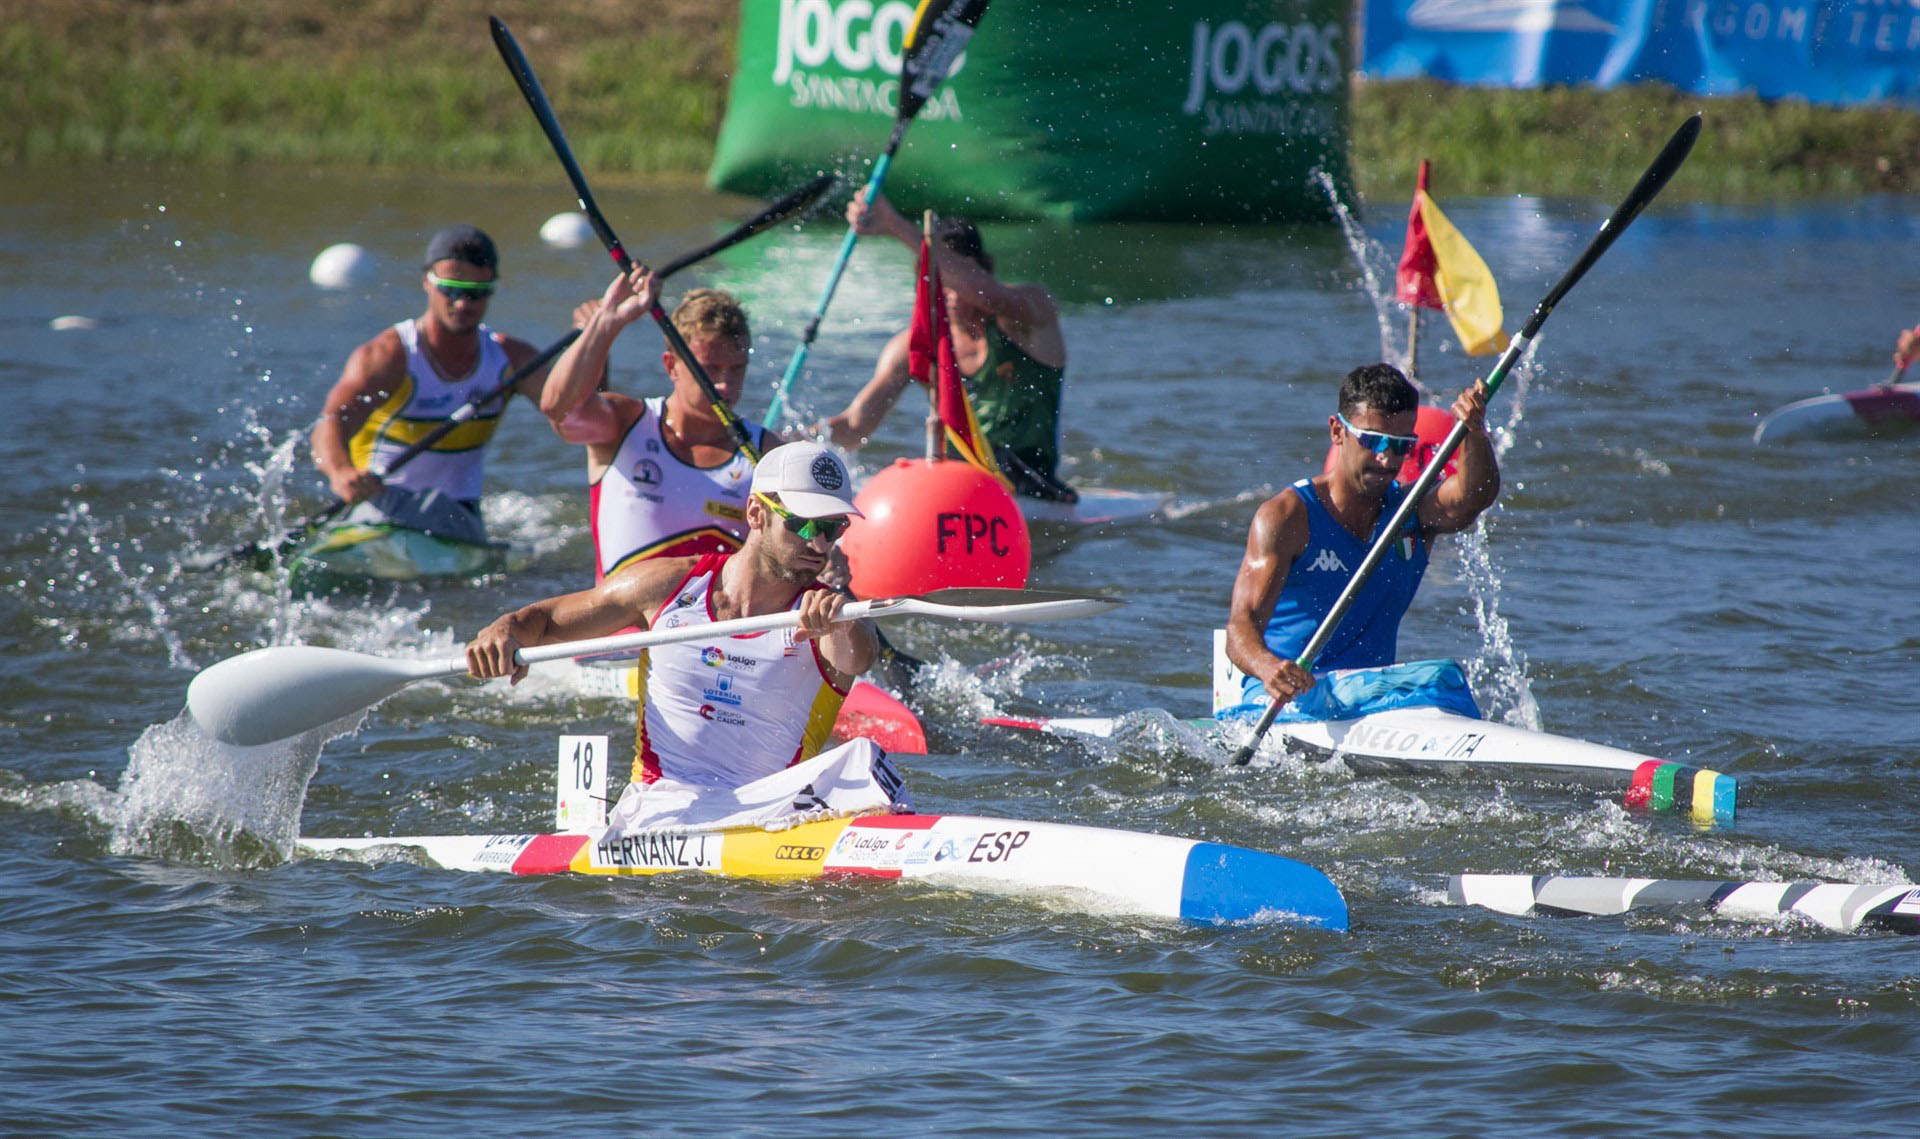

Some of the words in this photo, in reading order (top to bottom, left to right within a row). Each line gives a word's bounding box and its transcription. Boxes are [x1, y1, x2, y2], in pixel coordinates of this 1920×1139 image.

[772, 0, 966, 85] JOGO
[1182, 19, 1344, 115] JOGOS
[789, 70, 963, 122] SANTACSA
[937, 512, 1009, 557] FPC
[727, 654, 756, 666] LaLiga
[716, 716, 746, 726] CAUCHE
[717, 709, 742, 719] GRUPO
[1348, 724, 1419, 752] NELO
[1445, 733, 1486, 758] ITA
[573, 741, 593, 790] 18
[597, 835, 689, 866] HERNANZ
[694, 835, 711, 867] J.
[776, 844, 825, 860] NELO
[854, 836, 890, 851] LaLiga
[968, 831, 1030, 863] ESP
